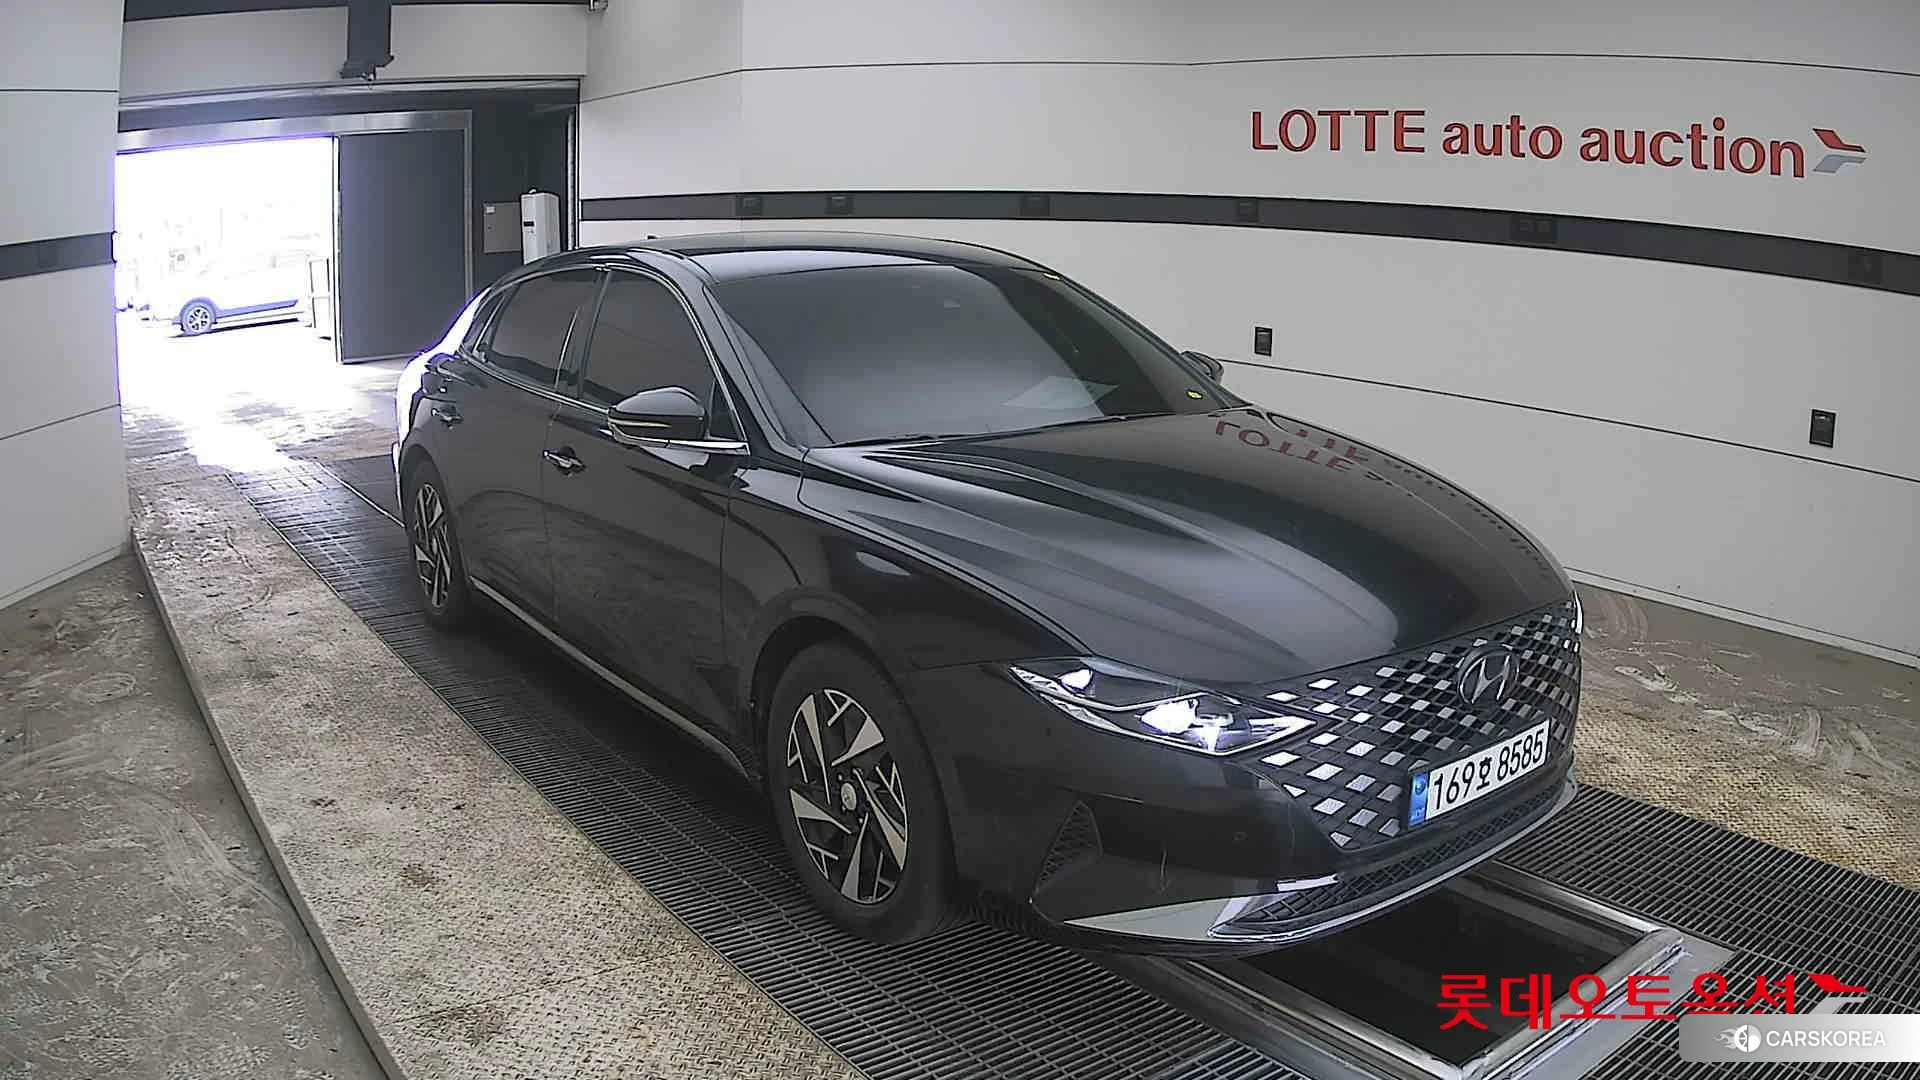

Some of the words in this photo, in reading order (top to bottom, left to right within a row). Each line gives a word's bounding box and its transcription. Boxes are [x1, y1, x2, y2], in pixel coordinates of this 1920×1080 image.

[1252, 109, 1425, 152] LOTTE
[1442, 115, 1563, 159] auto
[1579, 117, 1805, 178] auction
[1497, 728, 1545, 780] 8585
